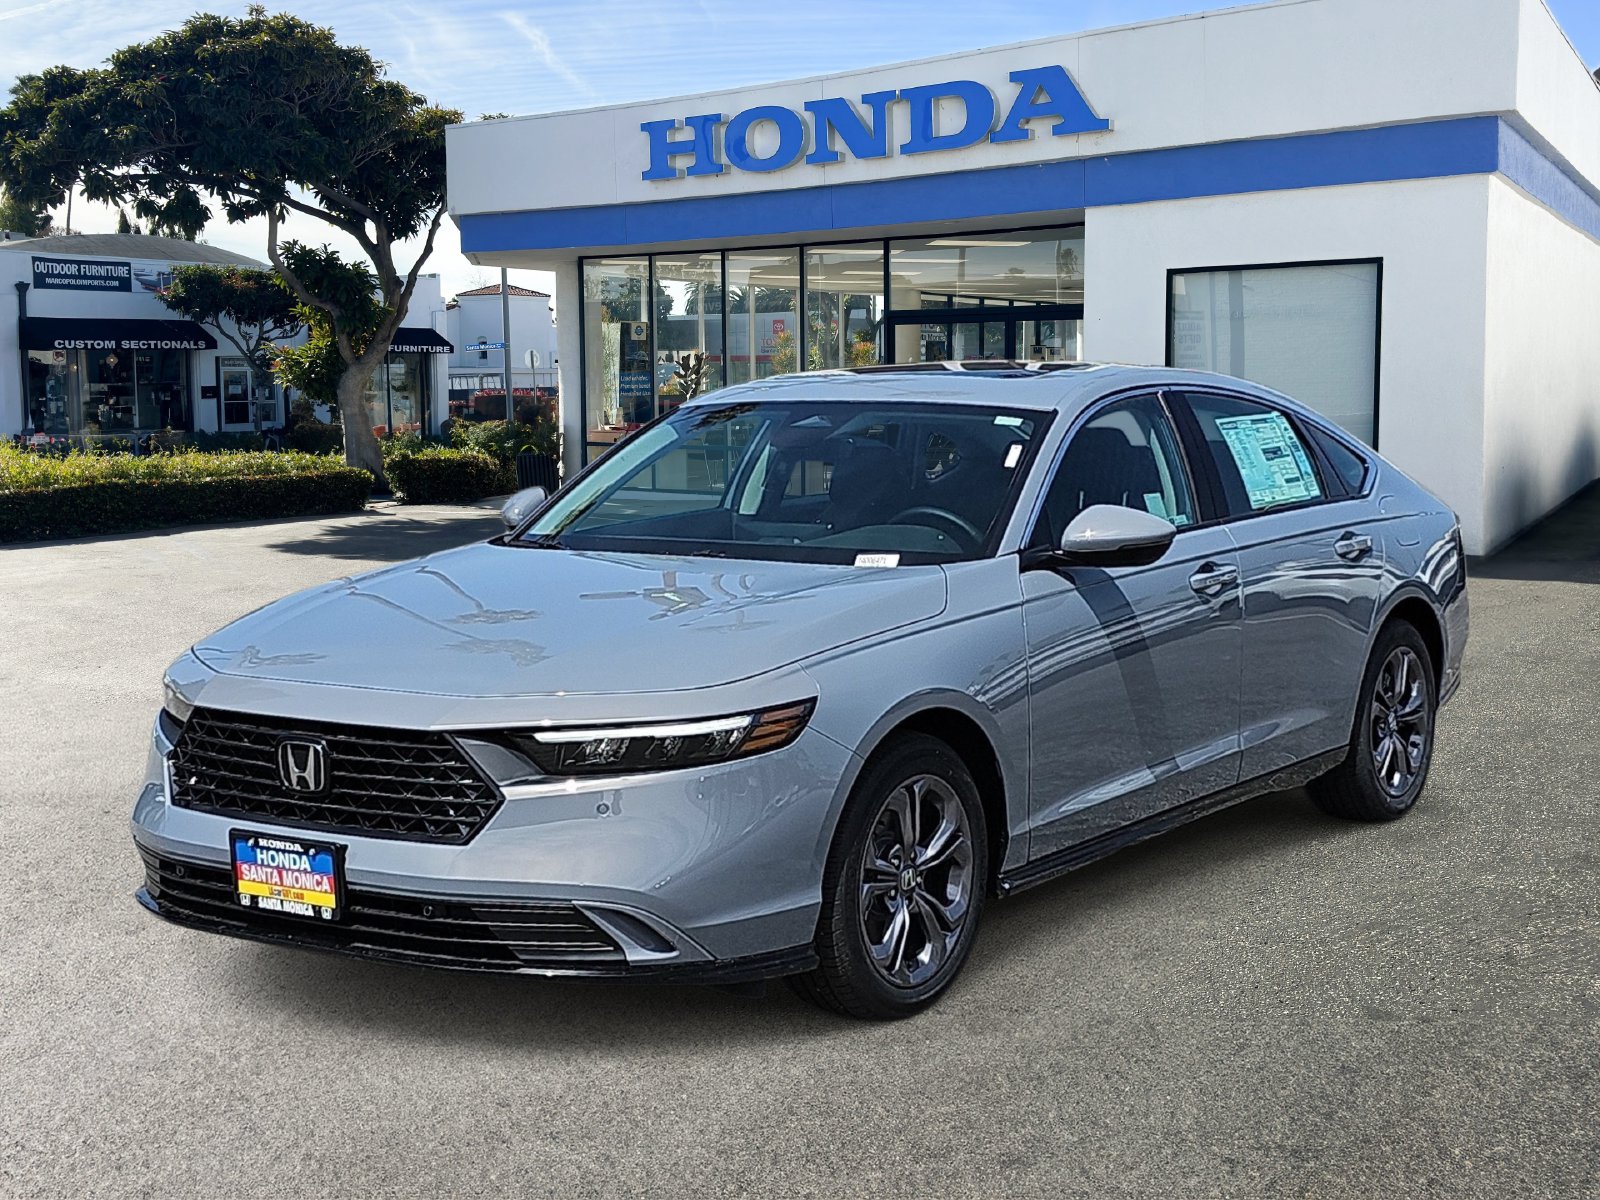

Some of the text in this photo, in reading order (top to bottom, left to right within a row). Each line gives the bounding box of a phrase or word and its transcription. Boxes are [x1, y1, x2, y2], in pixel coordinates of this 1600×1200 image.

[640, 65, 1111, 181] HONDA
[34, 261, 130, 277] OUTDOOR FURNITURE
[45, 277, 119, 287] MARCOPOLOIMPORTS.COM
[54, 339, 206, 349] CUSTOM SECTIONALS
[388, 344, 451, 353] FURNITURE
[258, 838, 304, 852] HONDA
[256, 848, 312, 872] HONDA
[241, 864, 331, 893] SANTA MONICA
[258, 896, 315, 917] SANTA MONICA
